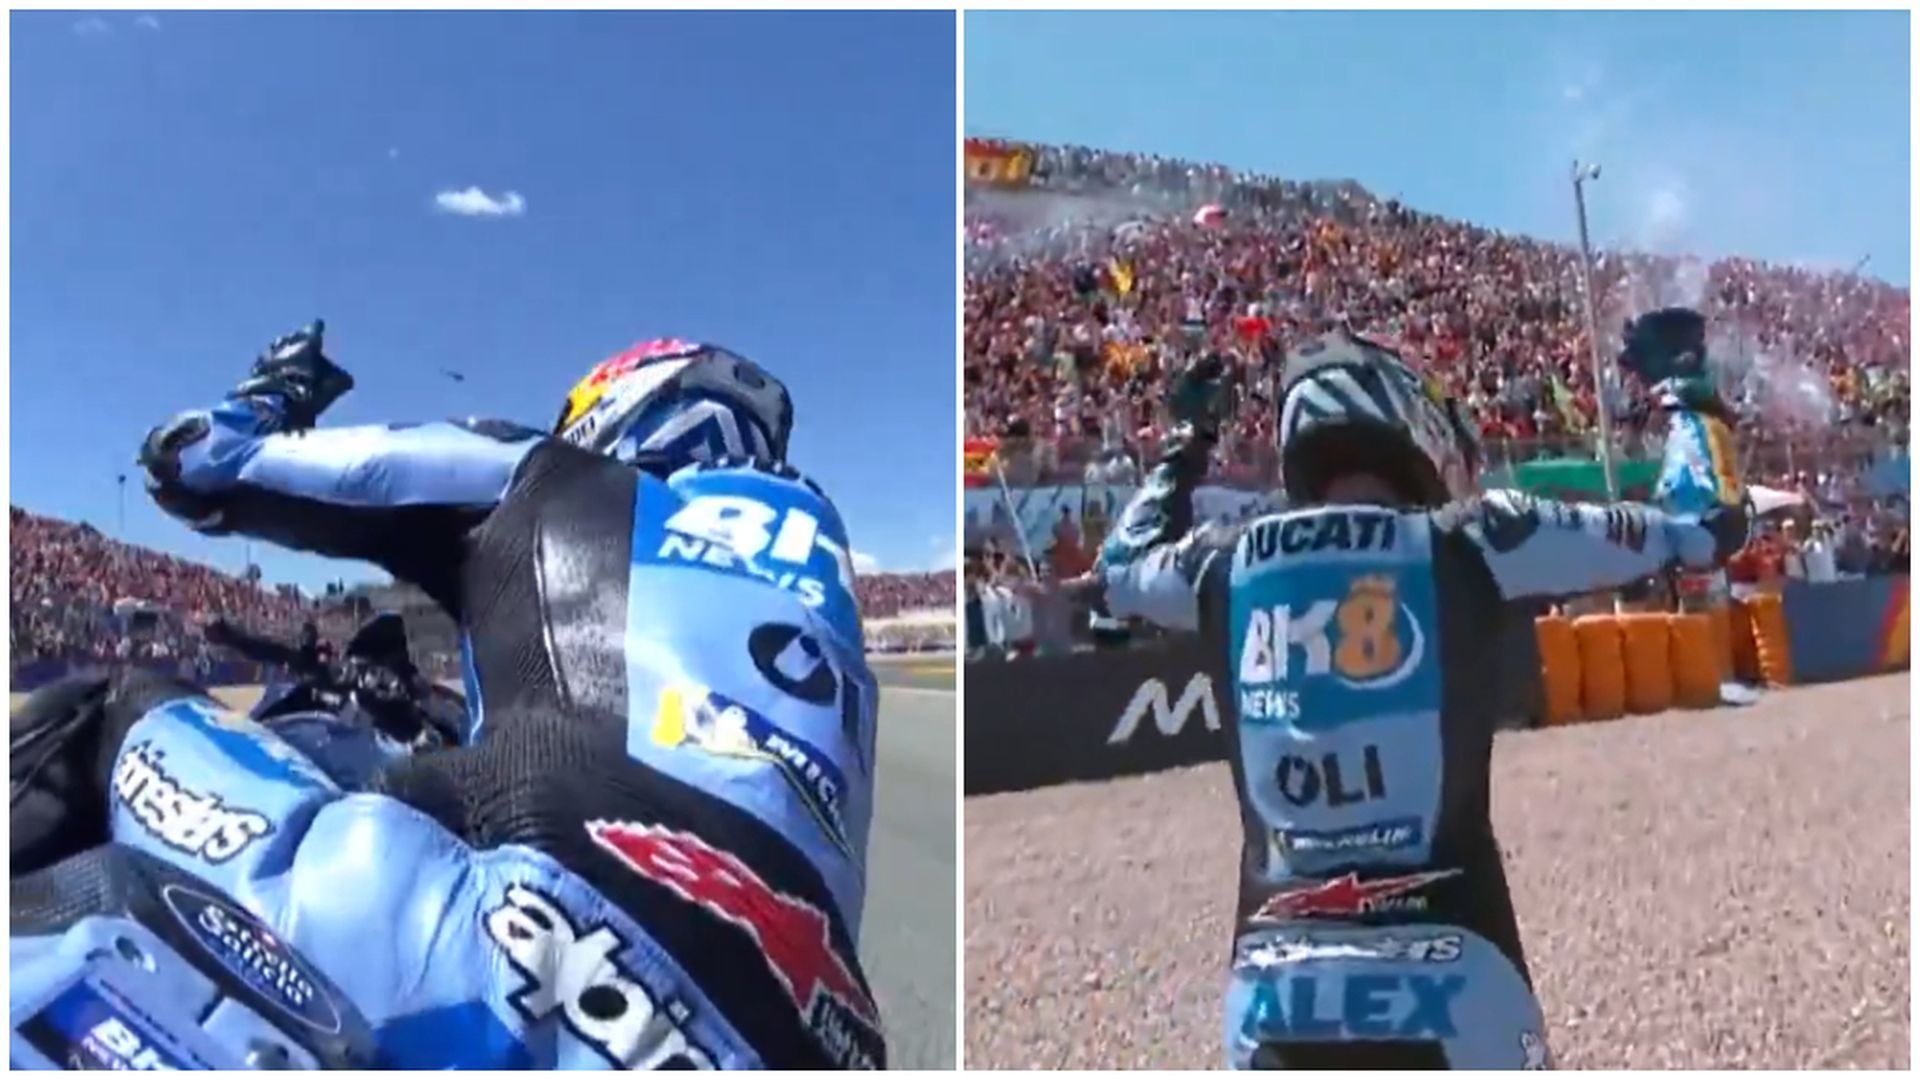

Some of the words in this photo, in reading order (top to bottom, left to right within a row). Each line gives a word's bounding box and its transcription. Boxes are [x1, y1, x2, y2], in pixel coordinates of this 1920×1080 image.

[1239, 588, 1400, 684] BK8
[1241, 689, 1301, 723] NEWS
[1276, 744, 1386, 808] OLI
[1241, 974, 1467, 1040] ALEX
